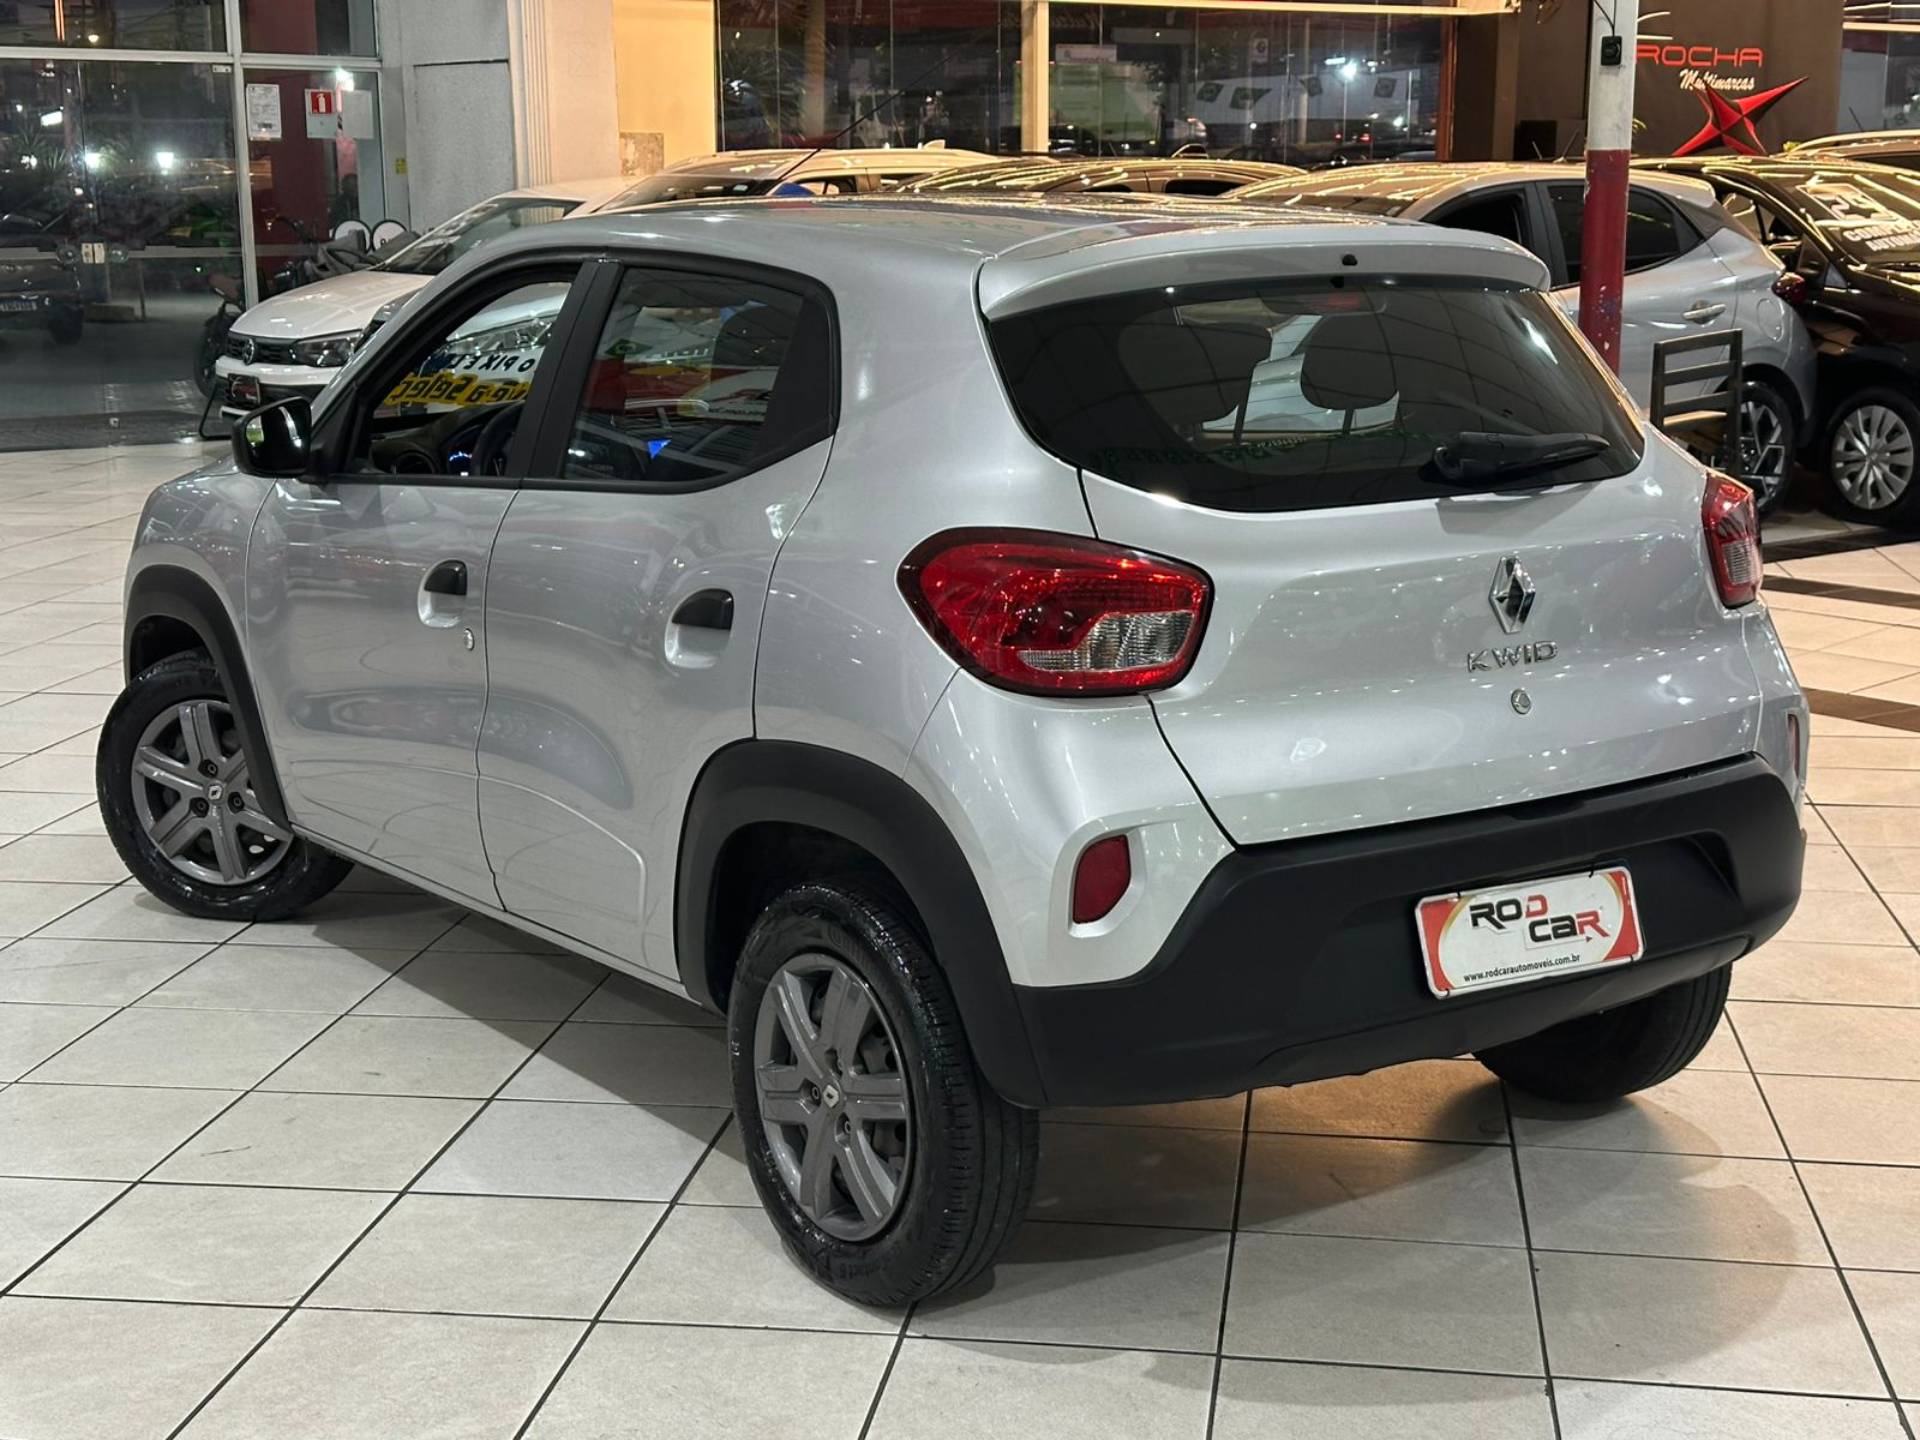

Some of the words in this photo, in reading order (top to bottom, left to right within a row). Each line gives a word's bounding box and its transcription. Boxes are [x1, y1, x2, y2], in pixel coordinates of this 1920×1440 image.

[1635, 44, 1764, 68] ROCHA
[1467, 640, 1558, 673] KWID
[1469, 894, 1548, 930] ROD
[1463, 952, 1581, 983] www.rodcarautomoveis.com.br
